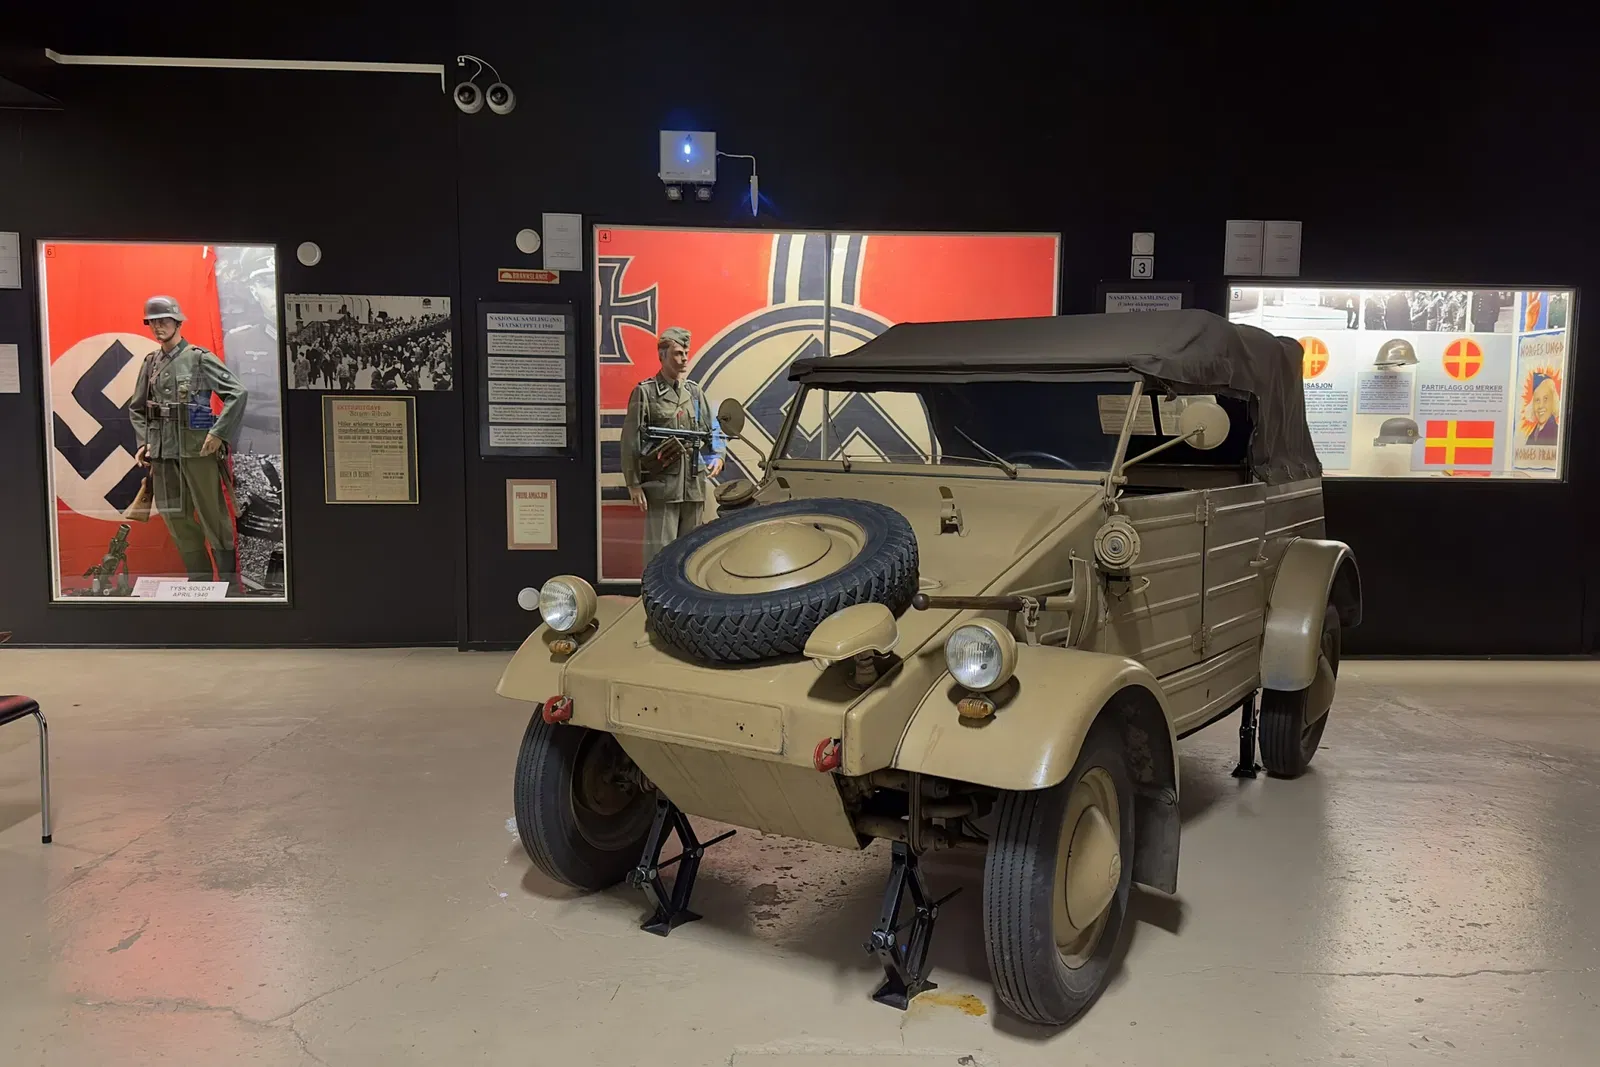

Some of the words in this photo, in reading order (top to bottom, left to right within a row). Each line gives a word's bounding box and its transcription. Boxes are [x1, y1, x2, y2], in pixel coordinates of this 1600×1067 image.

[47, 248, 52, 256] 6
[1138, 262, 1146, 274] 3
[1234, 291, 1239, 299] 5
[1520, 343, 1544, 357] NORGES
[1515, 448, 1536, 460] NORGES
